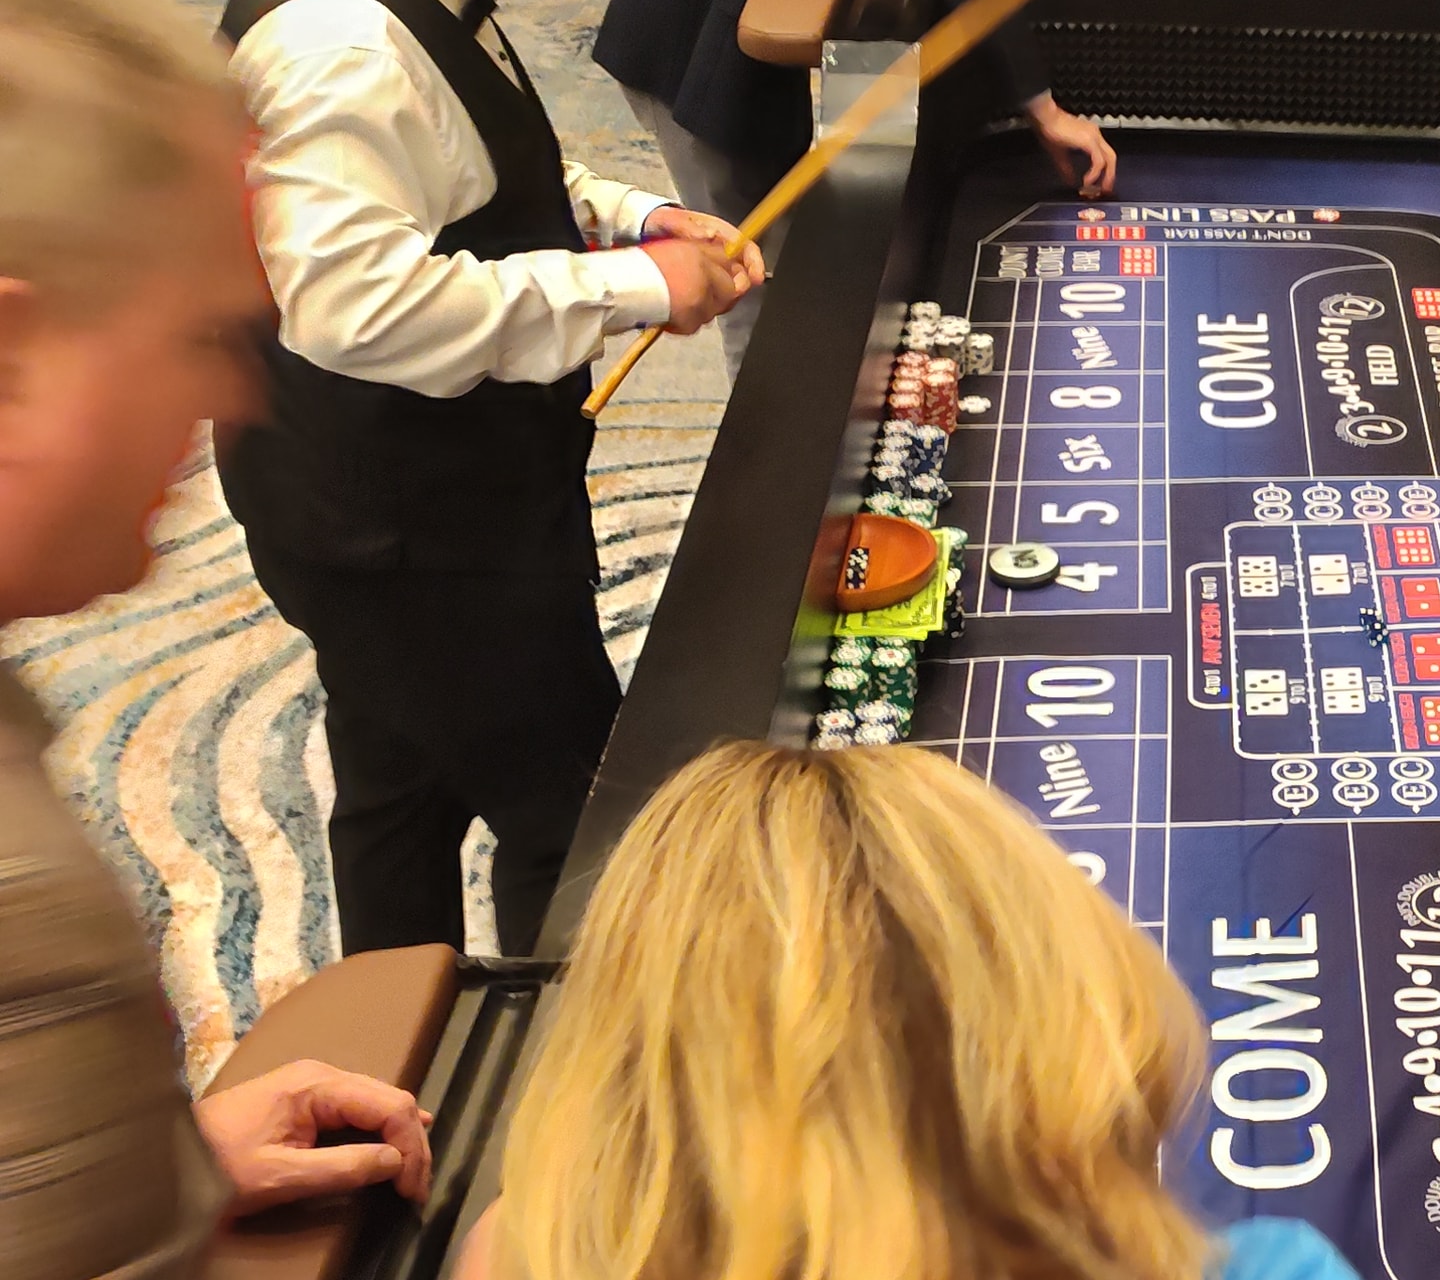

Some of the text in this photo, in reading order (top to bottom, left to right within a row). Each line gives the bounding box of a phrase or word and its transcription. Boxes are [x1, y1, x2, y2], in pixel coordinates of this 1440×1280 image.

[1120, 206, 1297, 224] PASS LINE
[1164, 227, 1201, 240] BAR
[1204, 228, 1248, 240] PASS
[1059, 282, 1126, 319] 10
[1339, 296, 1376, 318] 12
[1071, 325, 1118, 370] Nine
[1197, 312, 1277, 429] COME
[1366, 344, 1400, 386] FIELD
[1050, 385, 1122, 409] 8
[1357, 421, 1393, 437] 2
[1057, 433, 1112, 473] Six
[1041, 500, 1120, 525] 5
[1055, 562, 1118, 592] 4
[1026, 666, 1115, 728] 10
[1038, 740, 1101, 818] Nine
[1210, 913, 1331, 1190] COME
